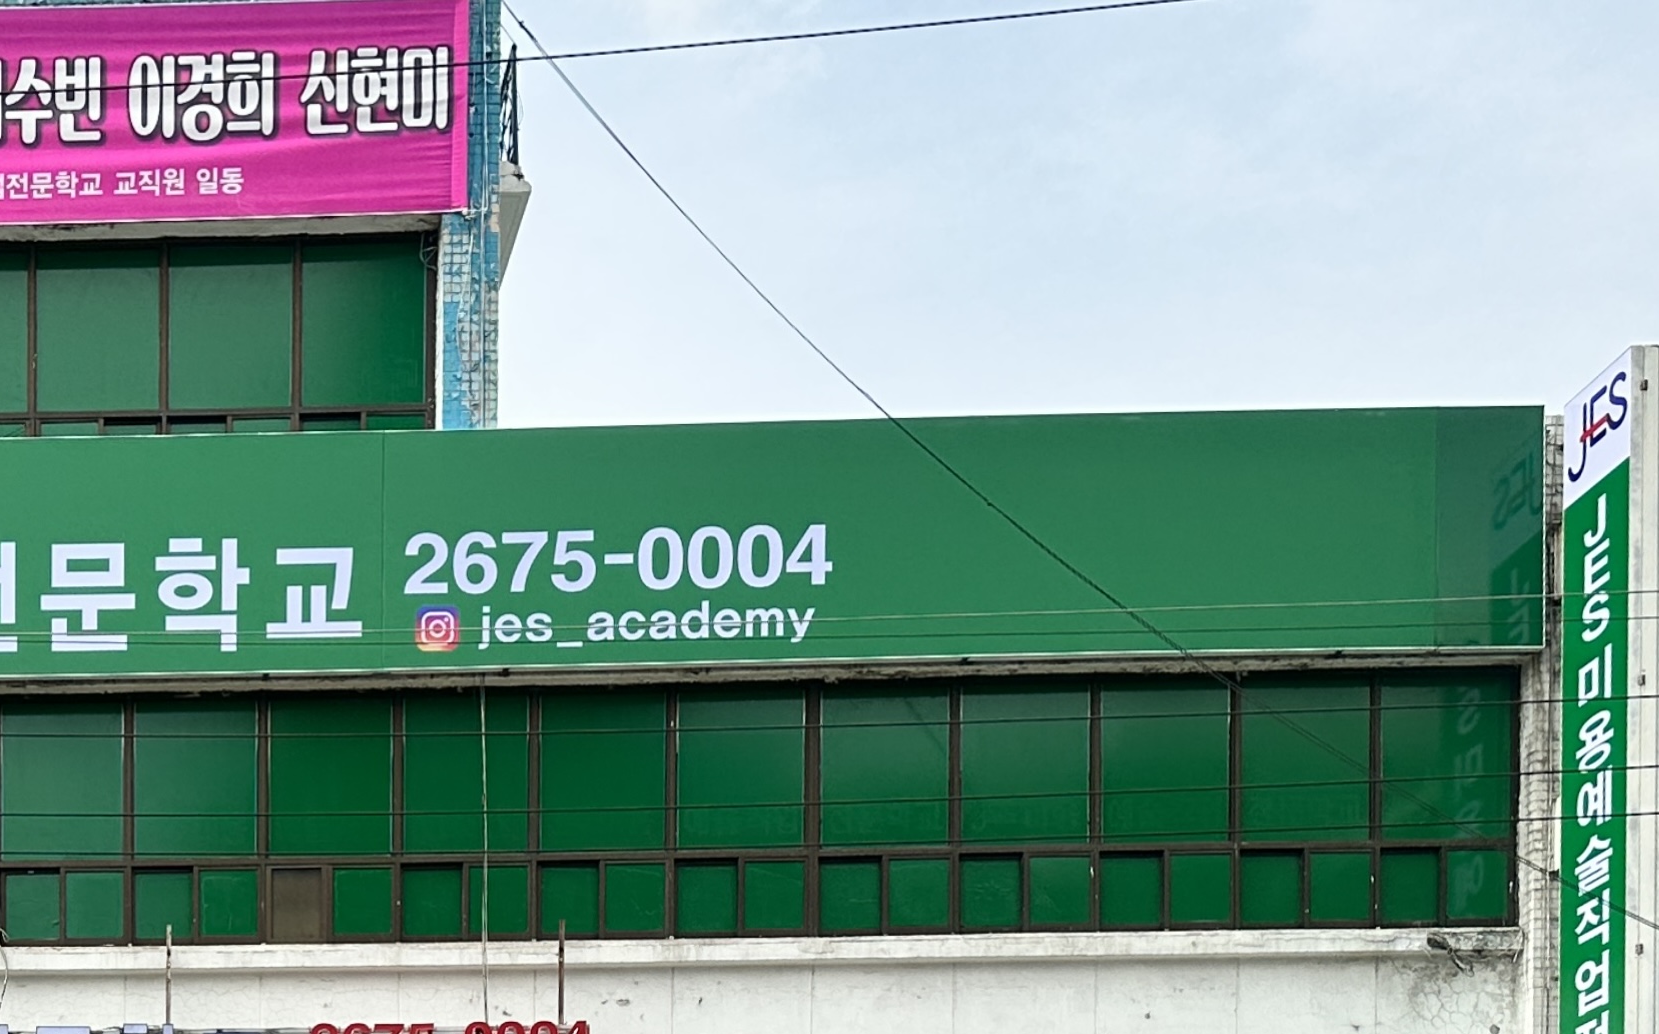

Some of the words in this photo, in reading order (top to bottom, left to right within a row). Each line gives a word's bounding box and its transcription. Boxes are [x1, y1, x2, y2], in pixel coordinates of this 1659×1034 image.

[128, 51, 275, 141] 이경희
[298, 46, 450, 136] 신현미
[113, 165, 185, 197] 교직원
[195, 165, 244, 196] 일동
[1568, 371, 1627, 482] JES
[403, 524, 833, 594] 2675-0004
[478, 603, 815, 649] jes_academy
